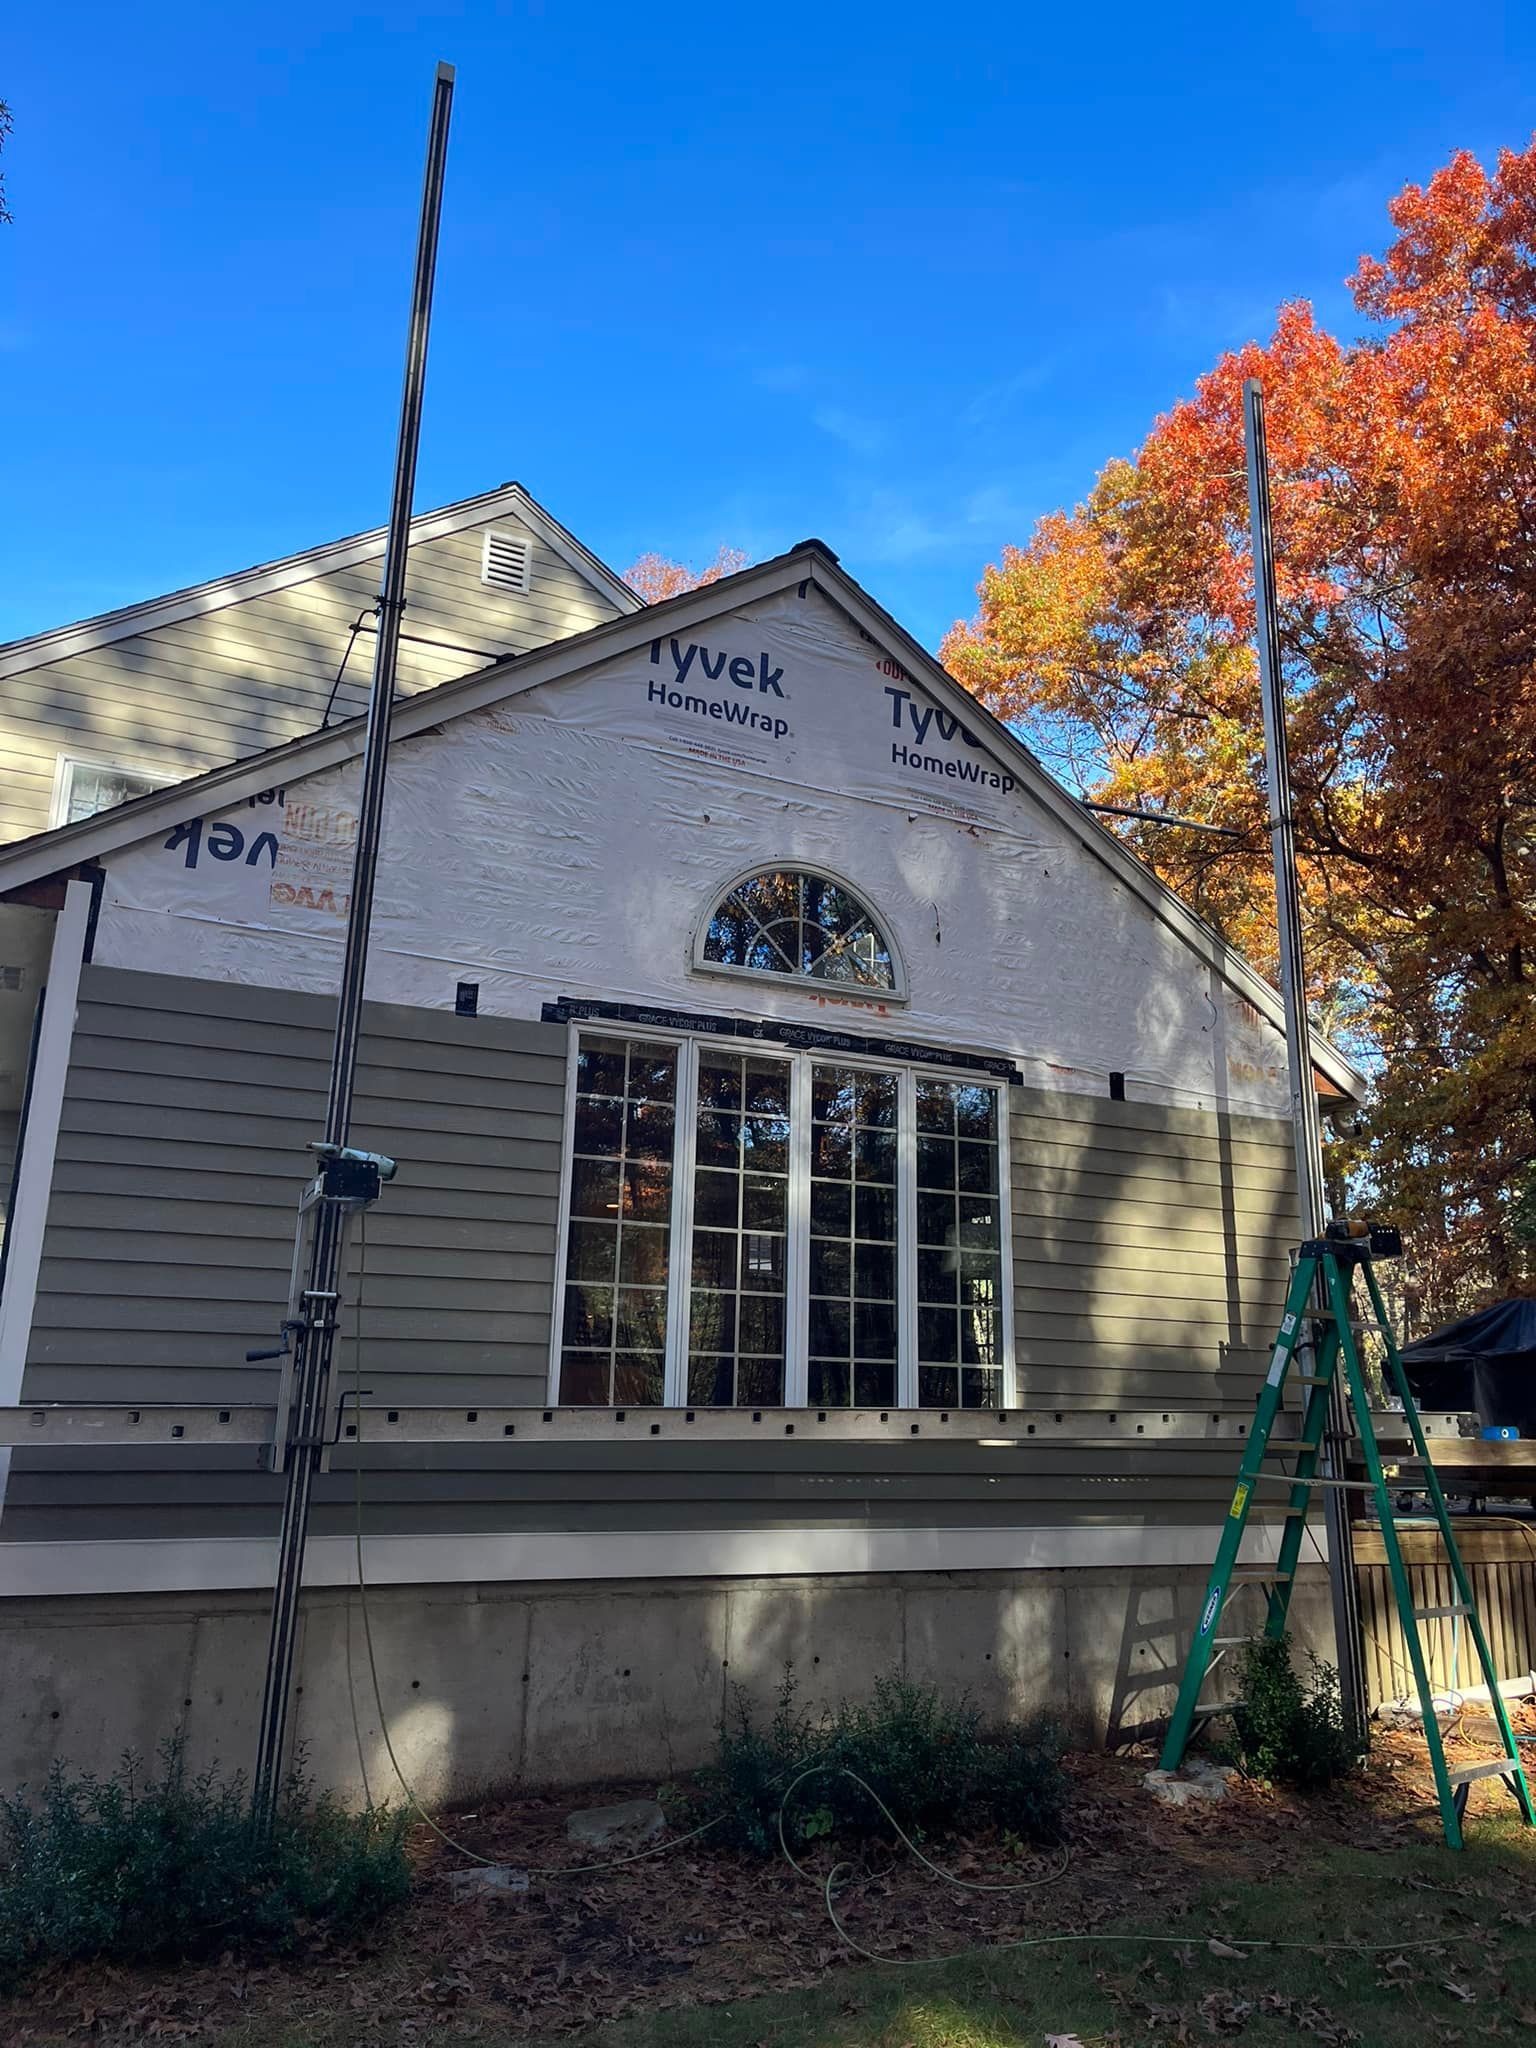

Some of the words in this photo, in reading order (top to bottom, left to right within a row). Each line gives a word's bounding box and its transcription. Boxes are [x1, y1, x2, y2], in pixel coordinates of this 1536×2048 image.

[648, 680, 788, 739] HomeWrap
[884, 686, 983, 748] Tyv
[892, 743, 1014, 795] HomeWrap
[164, 818, 279, 869] vek
[638, 1014, 667, 1025] GRACE
[697, 1020, 717, 1032] PLUS
[780, 1027, 806, 1040] GRACE
[833, 1035, 851, 1047] PLUS
[884, 1043, 909, 1056] GRACE
[984, 1060, 1008, 1071] GRACE
